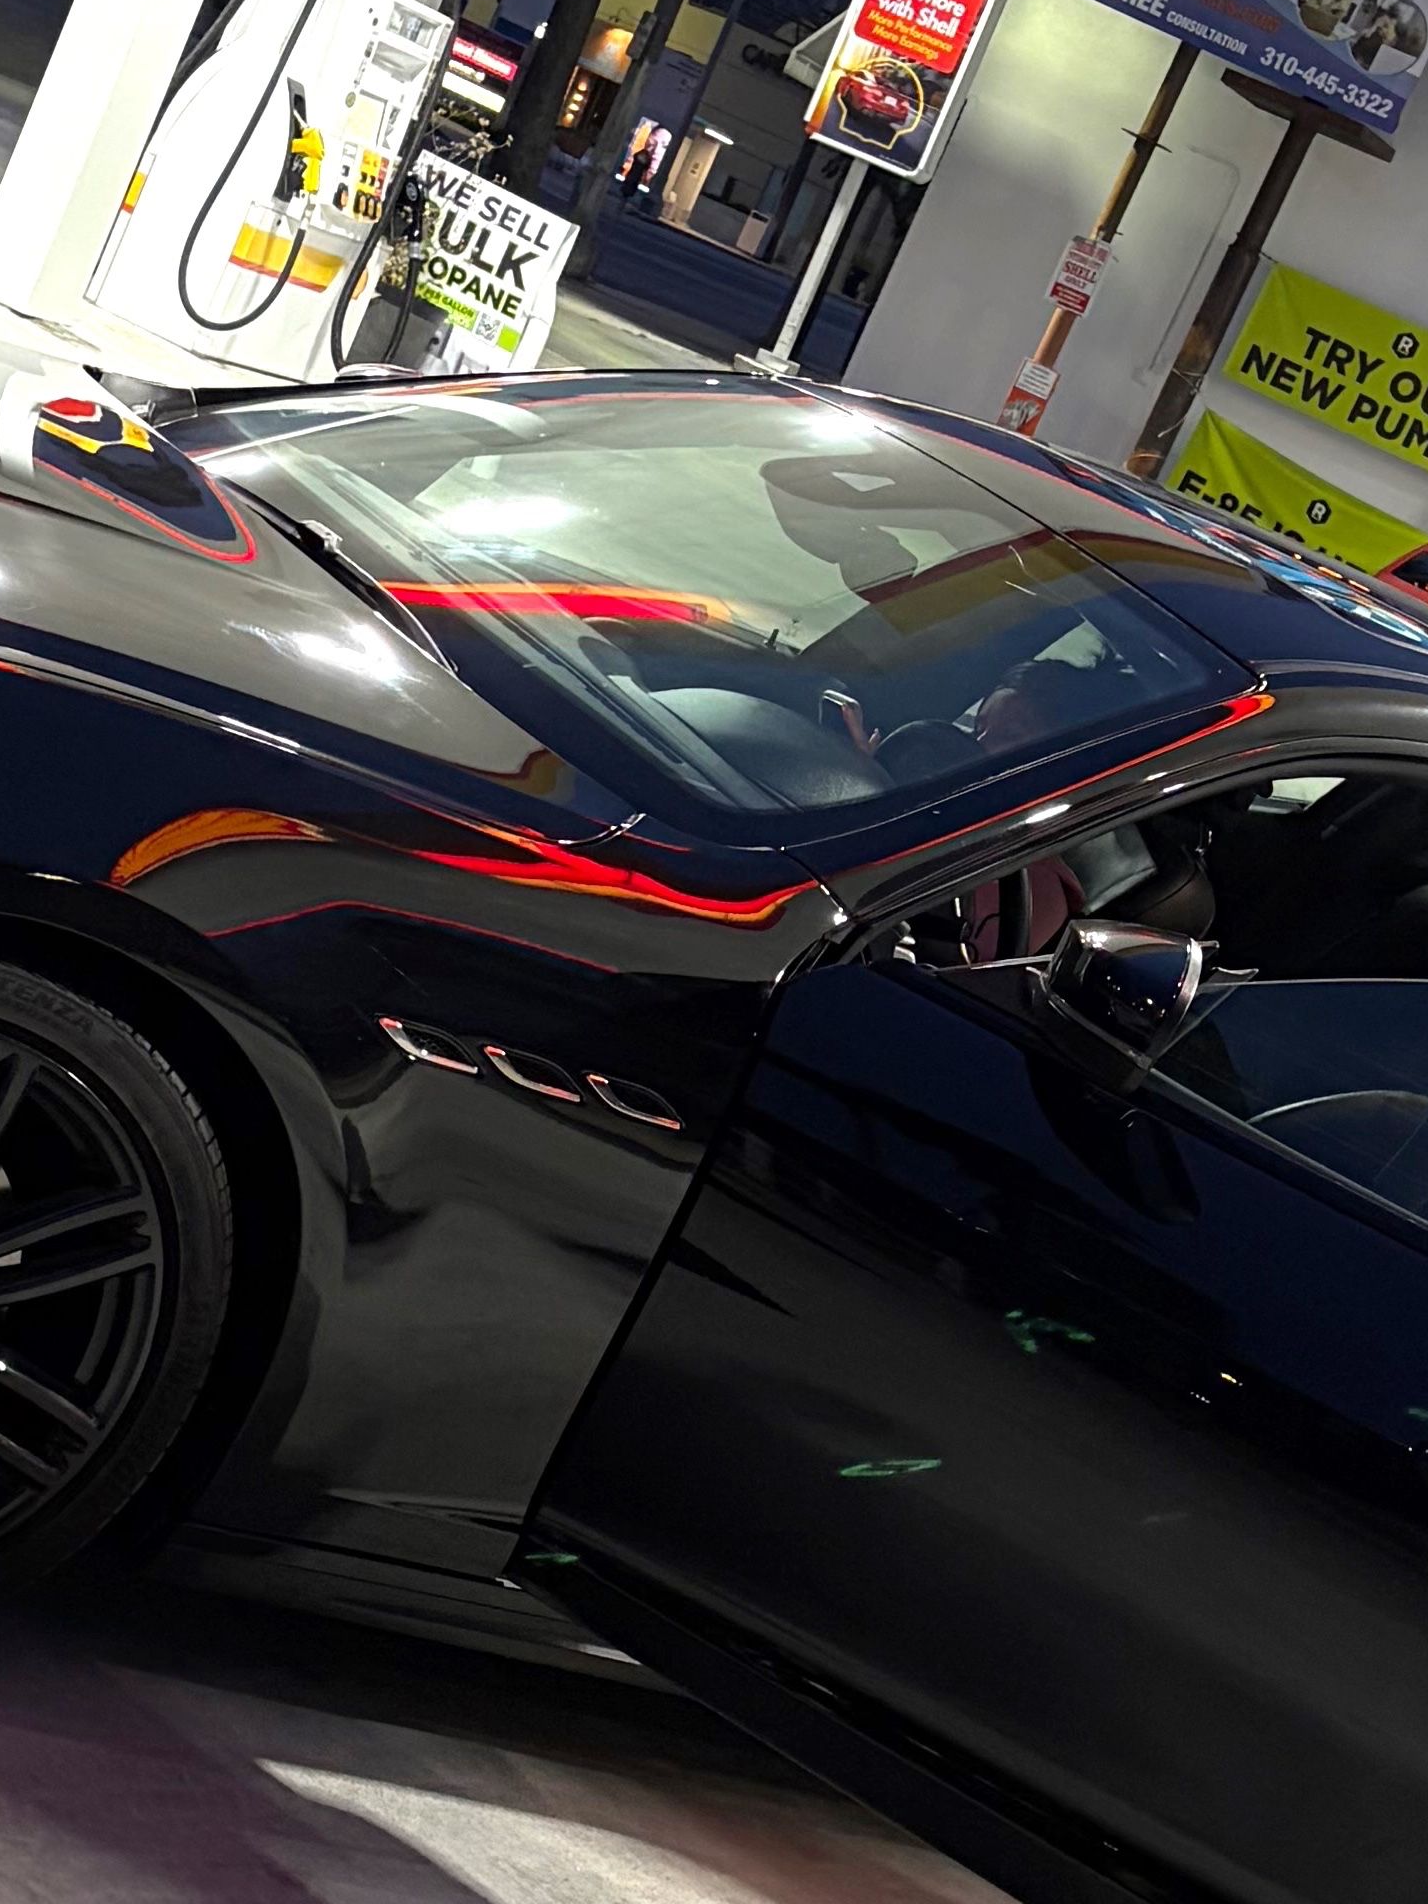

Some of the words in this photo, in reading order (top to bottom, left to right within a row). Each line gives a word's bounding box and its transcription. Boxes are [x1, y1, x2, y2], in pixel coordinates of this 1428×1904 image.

[867, 9, 893, 27] More
[893, 19, 953, 51] Performance
[872, 25, 898, 44] More
[919, 7, 960, 38] Shell
[1166, 10, 1249, 56] CONSULTATION
[1260, 47, 1395, 119] 310-445-3322
[426, 164, 478, 210] WE
[479, 196, 550, 251] SELL
[441, 291, 475, 317] GALLON
[1240, 343, 1346, 411] NEW
[1305, 326, 1385, 383] TRY
